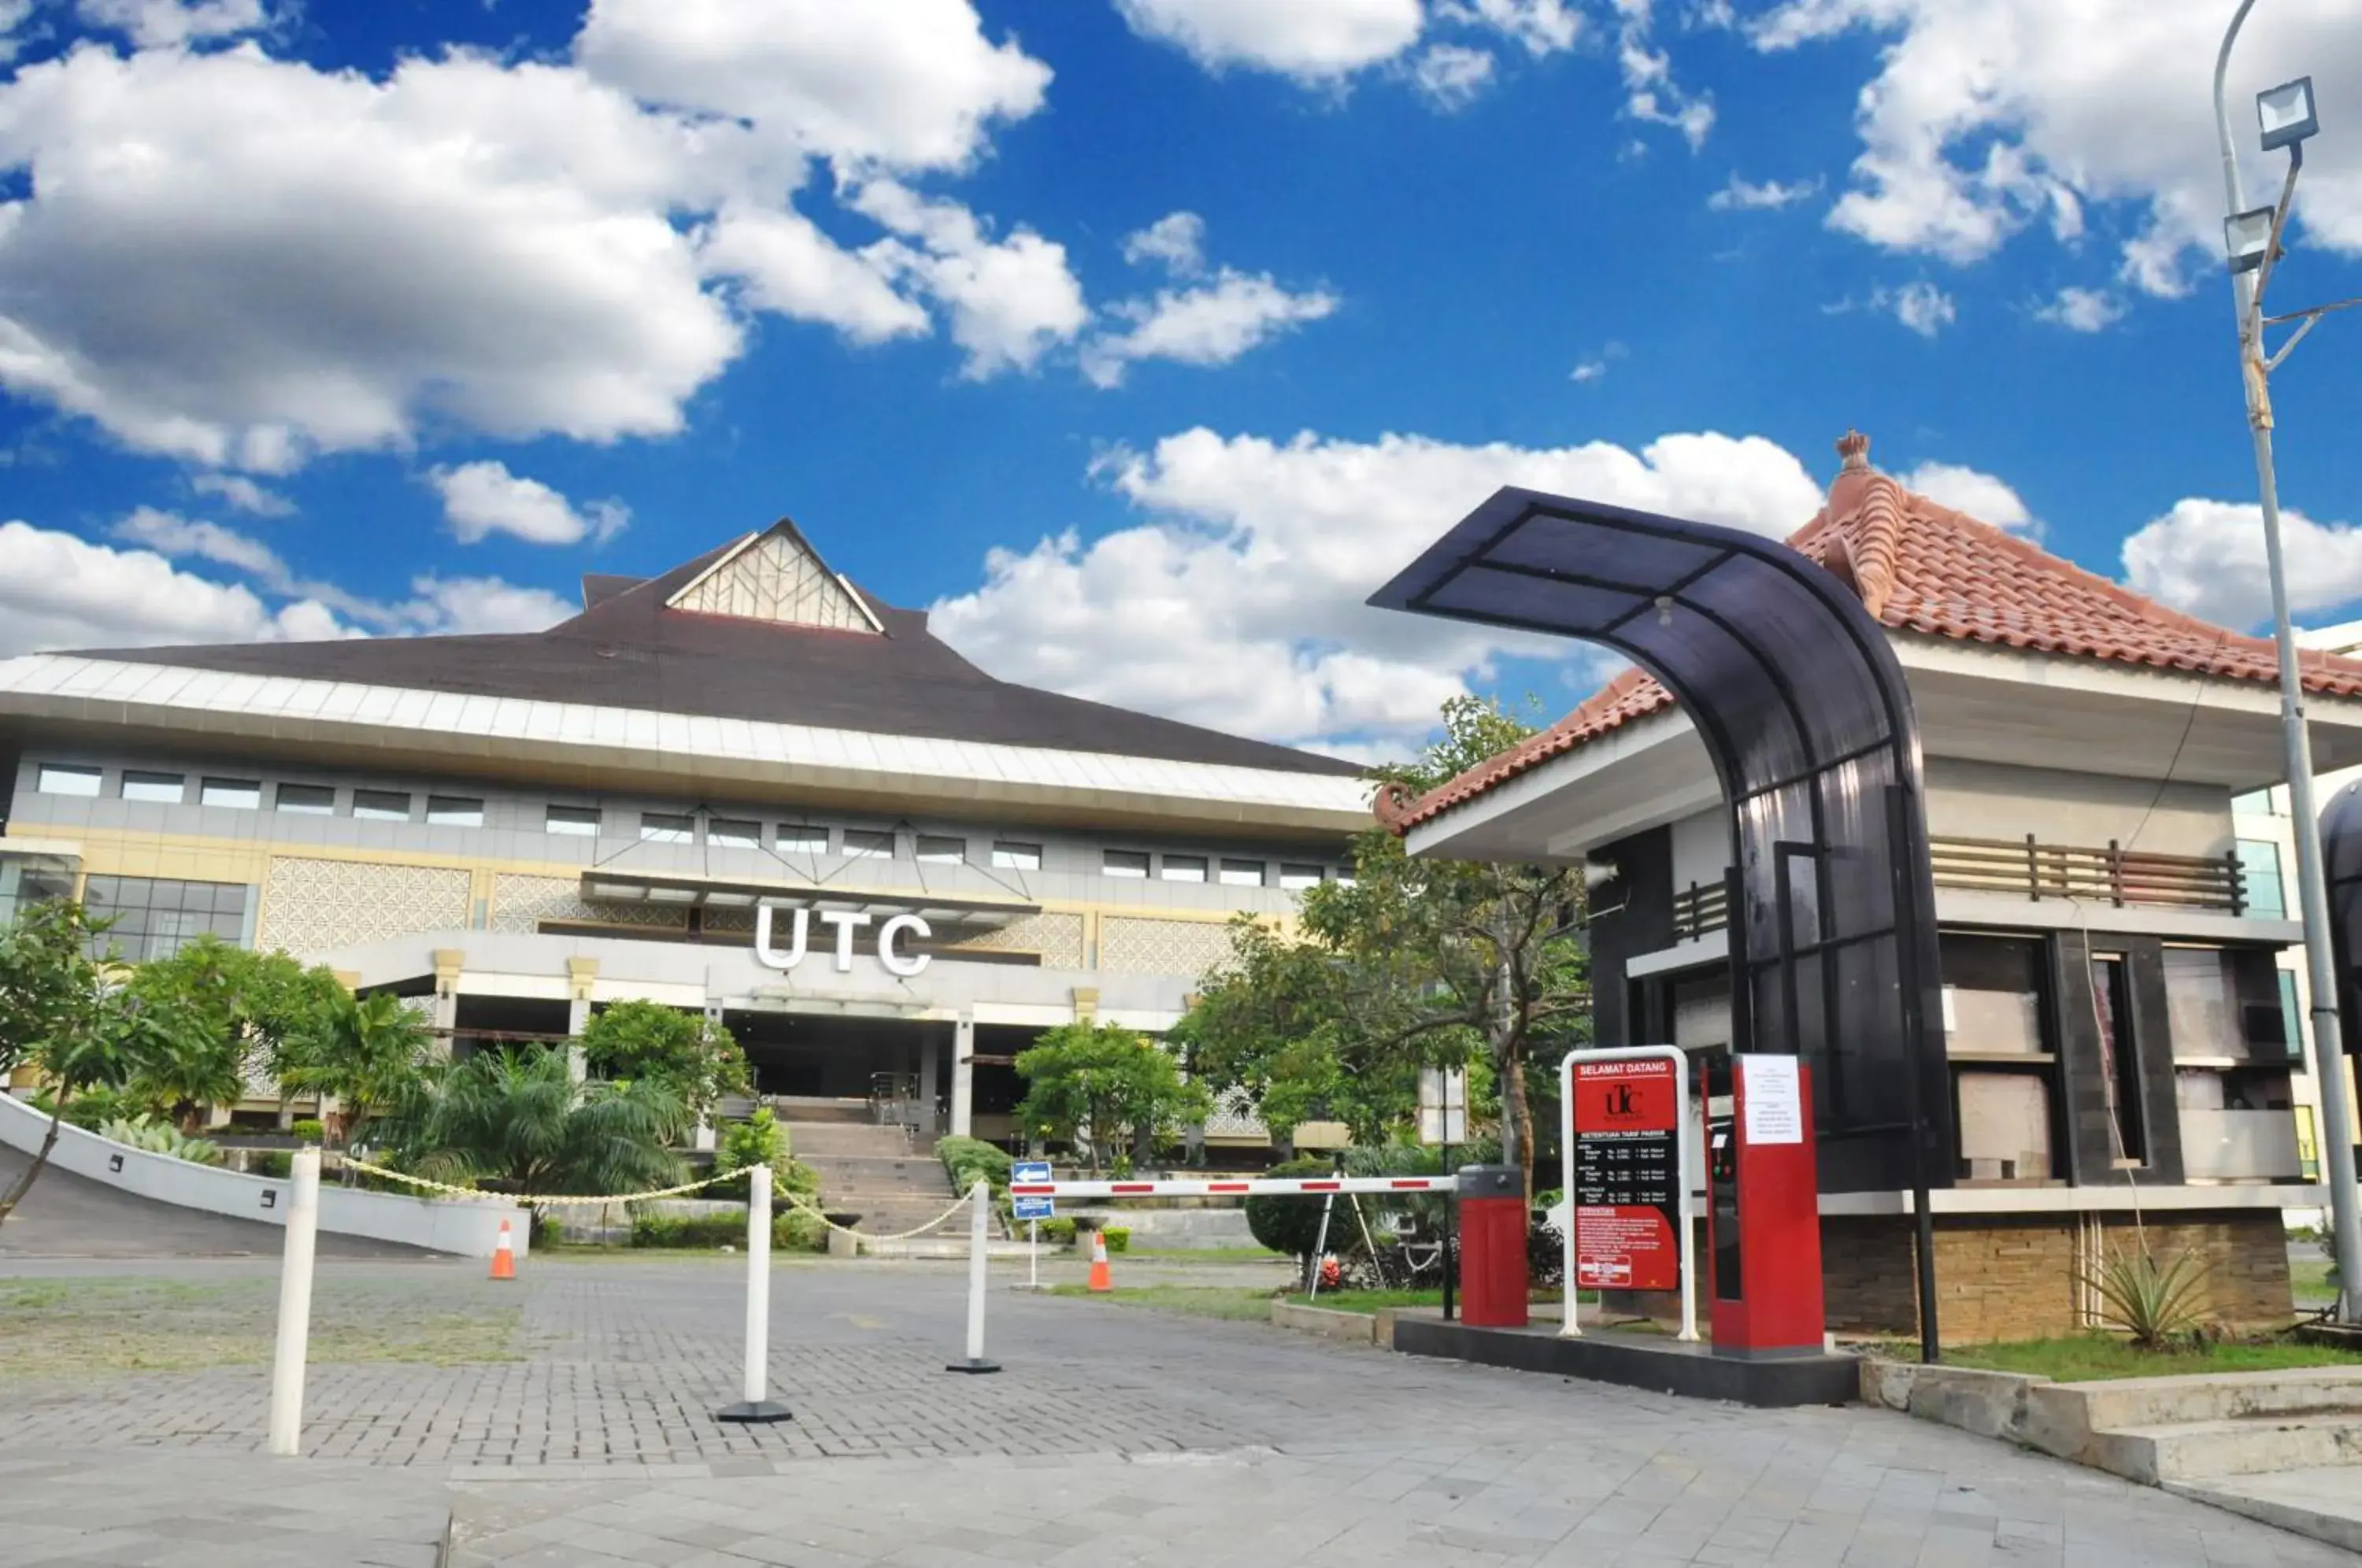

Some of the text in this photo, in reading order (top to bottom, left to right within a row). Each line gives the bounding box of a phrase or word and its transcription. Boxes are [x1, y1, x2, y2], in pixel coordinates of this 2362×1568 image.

[756, 904, 932, 977] UTC
[1579, 1061, 1667, 1075] SELAMAT DATANG
